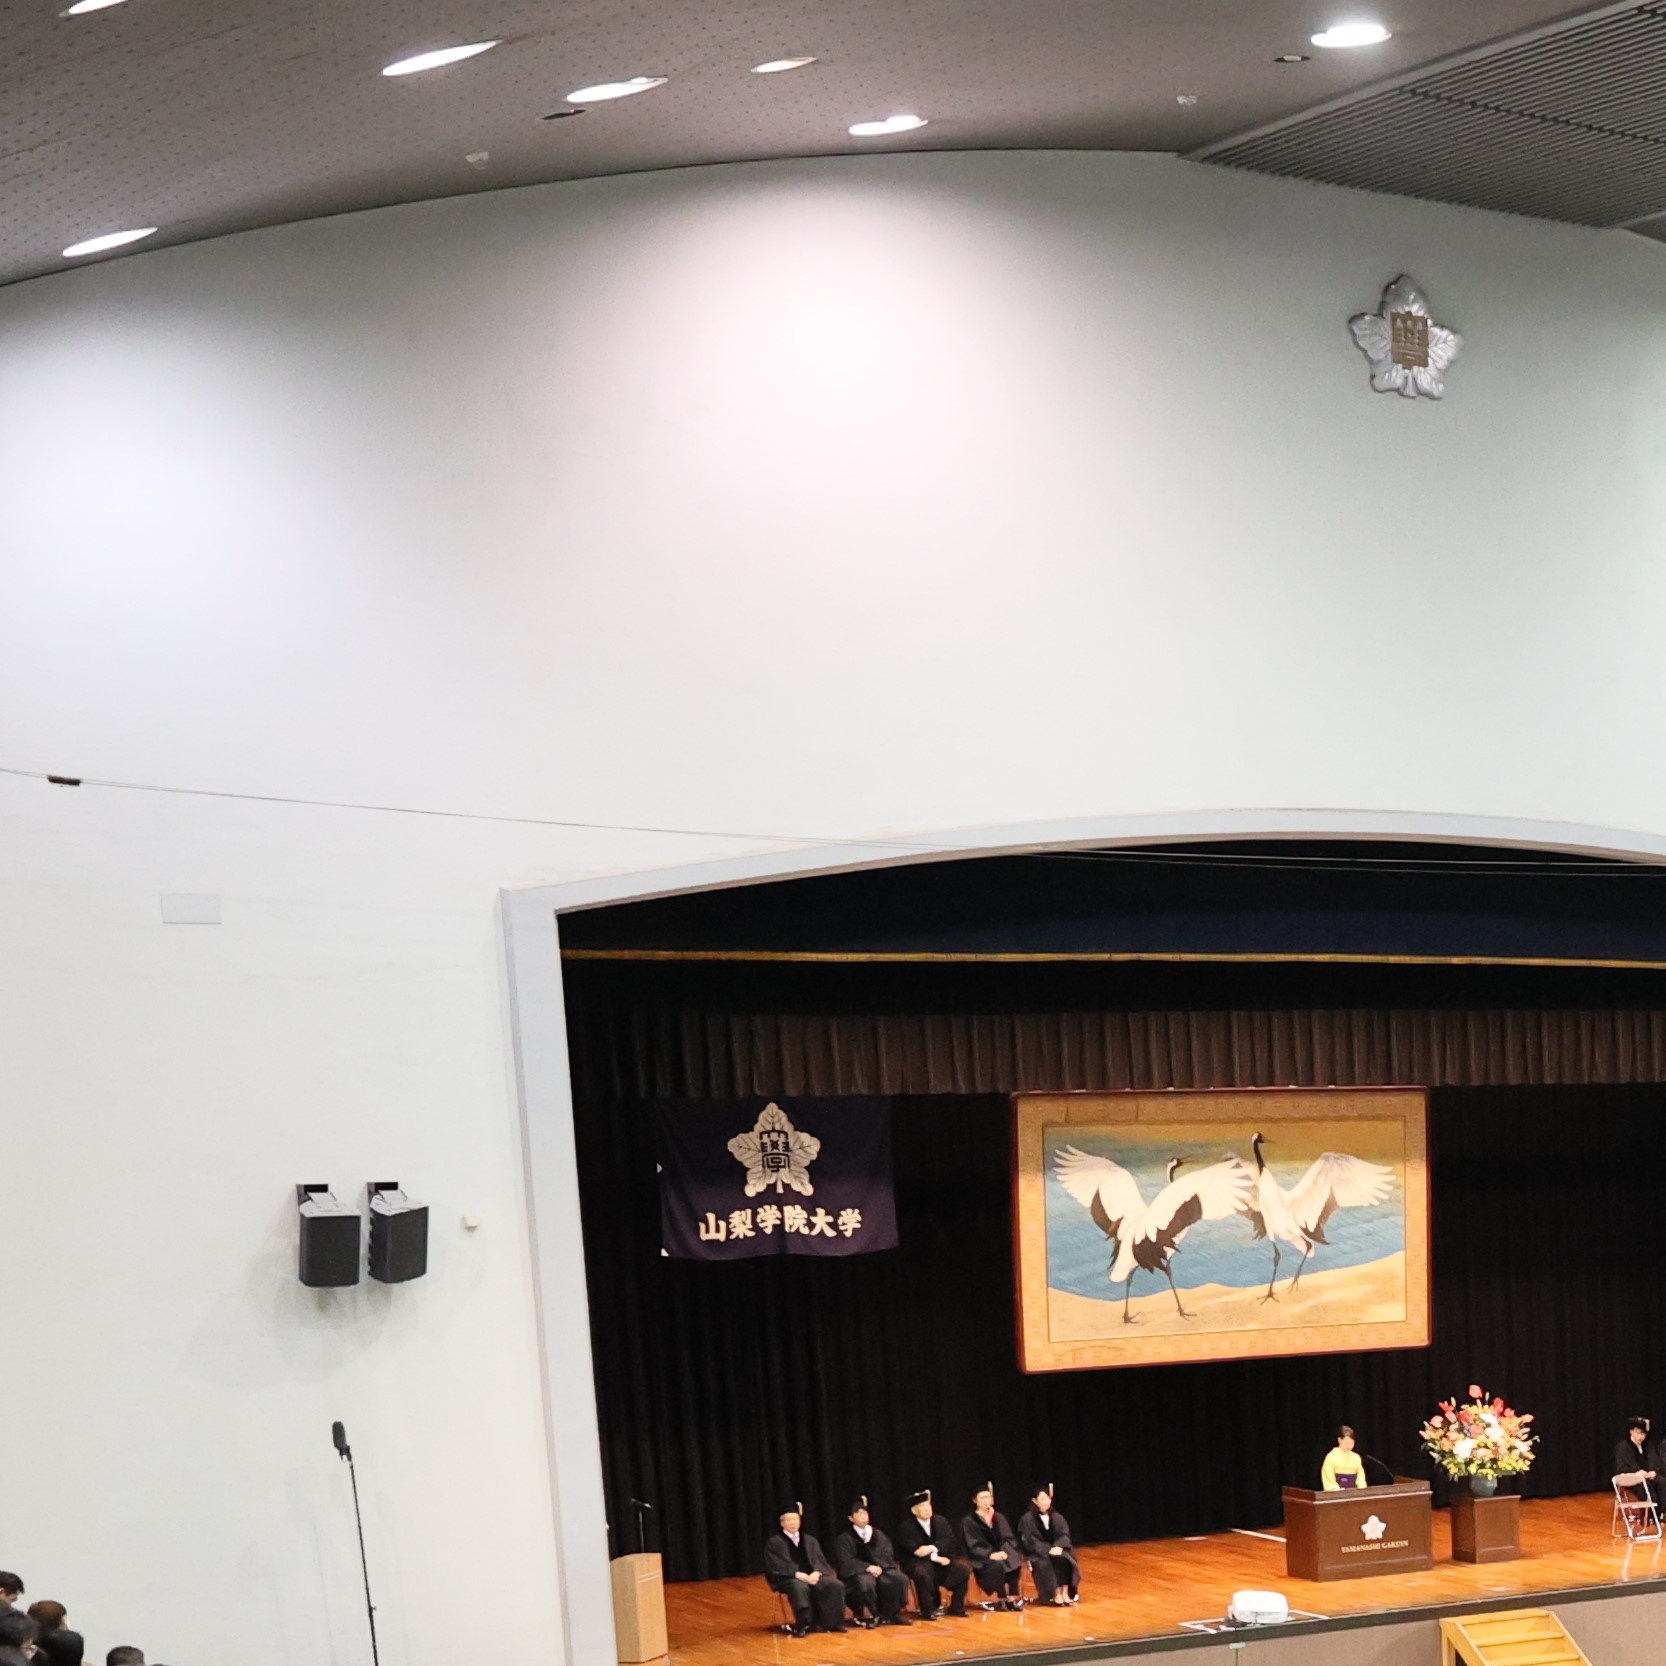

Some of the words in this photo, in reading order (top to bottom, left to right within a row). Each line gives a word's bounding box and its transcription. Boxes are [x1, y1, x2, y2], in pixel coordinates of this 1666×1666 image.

[698, 1205, 862, 1242] 山梨学院大学
